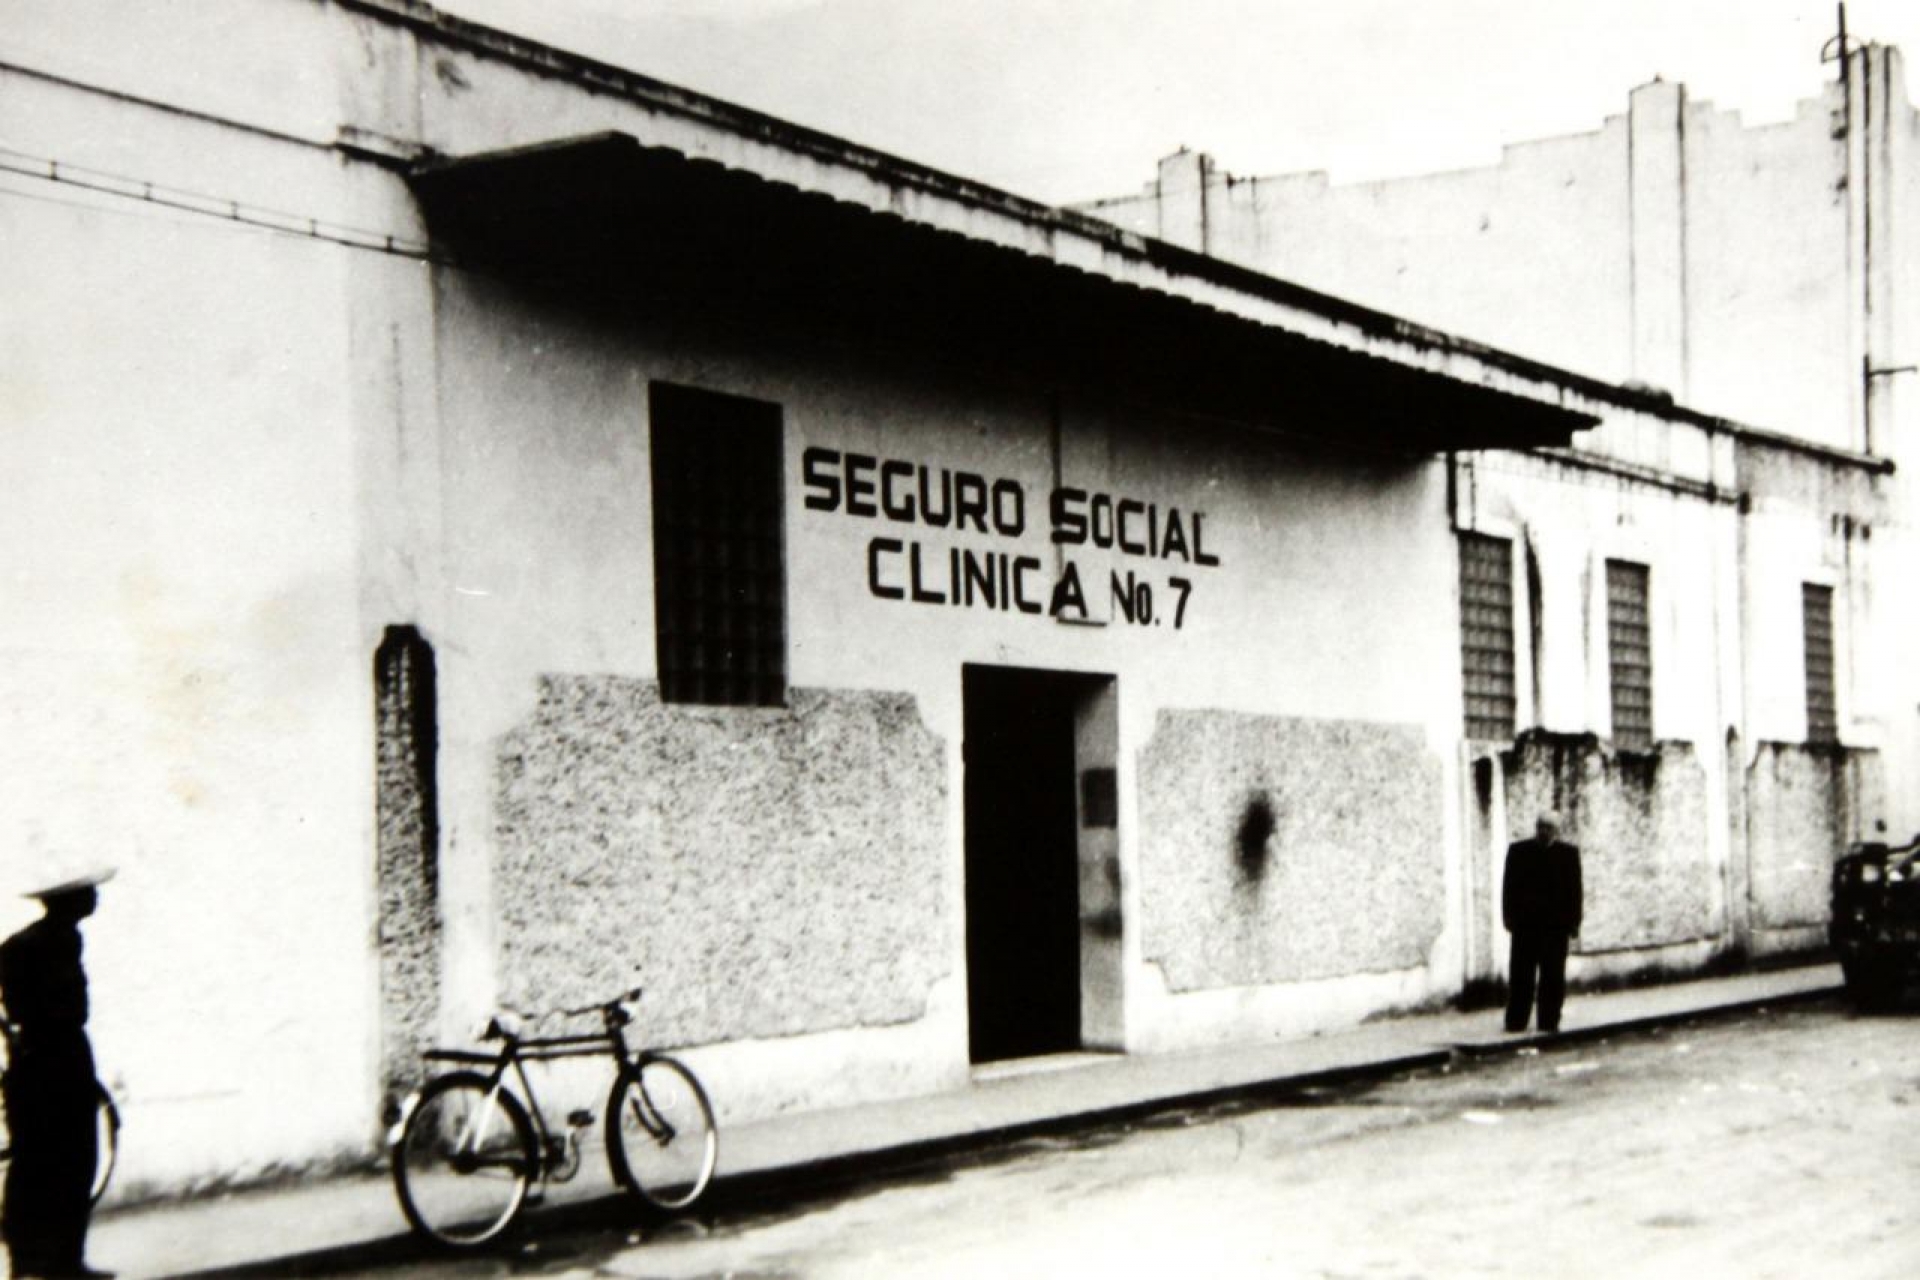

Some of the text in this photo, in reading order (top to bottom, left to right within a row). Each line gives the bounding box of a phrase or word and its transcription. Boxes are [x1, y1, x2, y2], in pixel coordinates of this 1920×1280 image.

[803, 447, 1220, 566] SEGURO SOCIAL
[868, 537, 1191, 629] CLINICA No. 7
